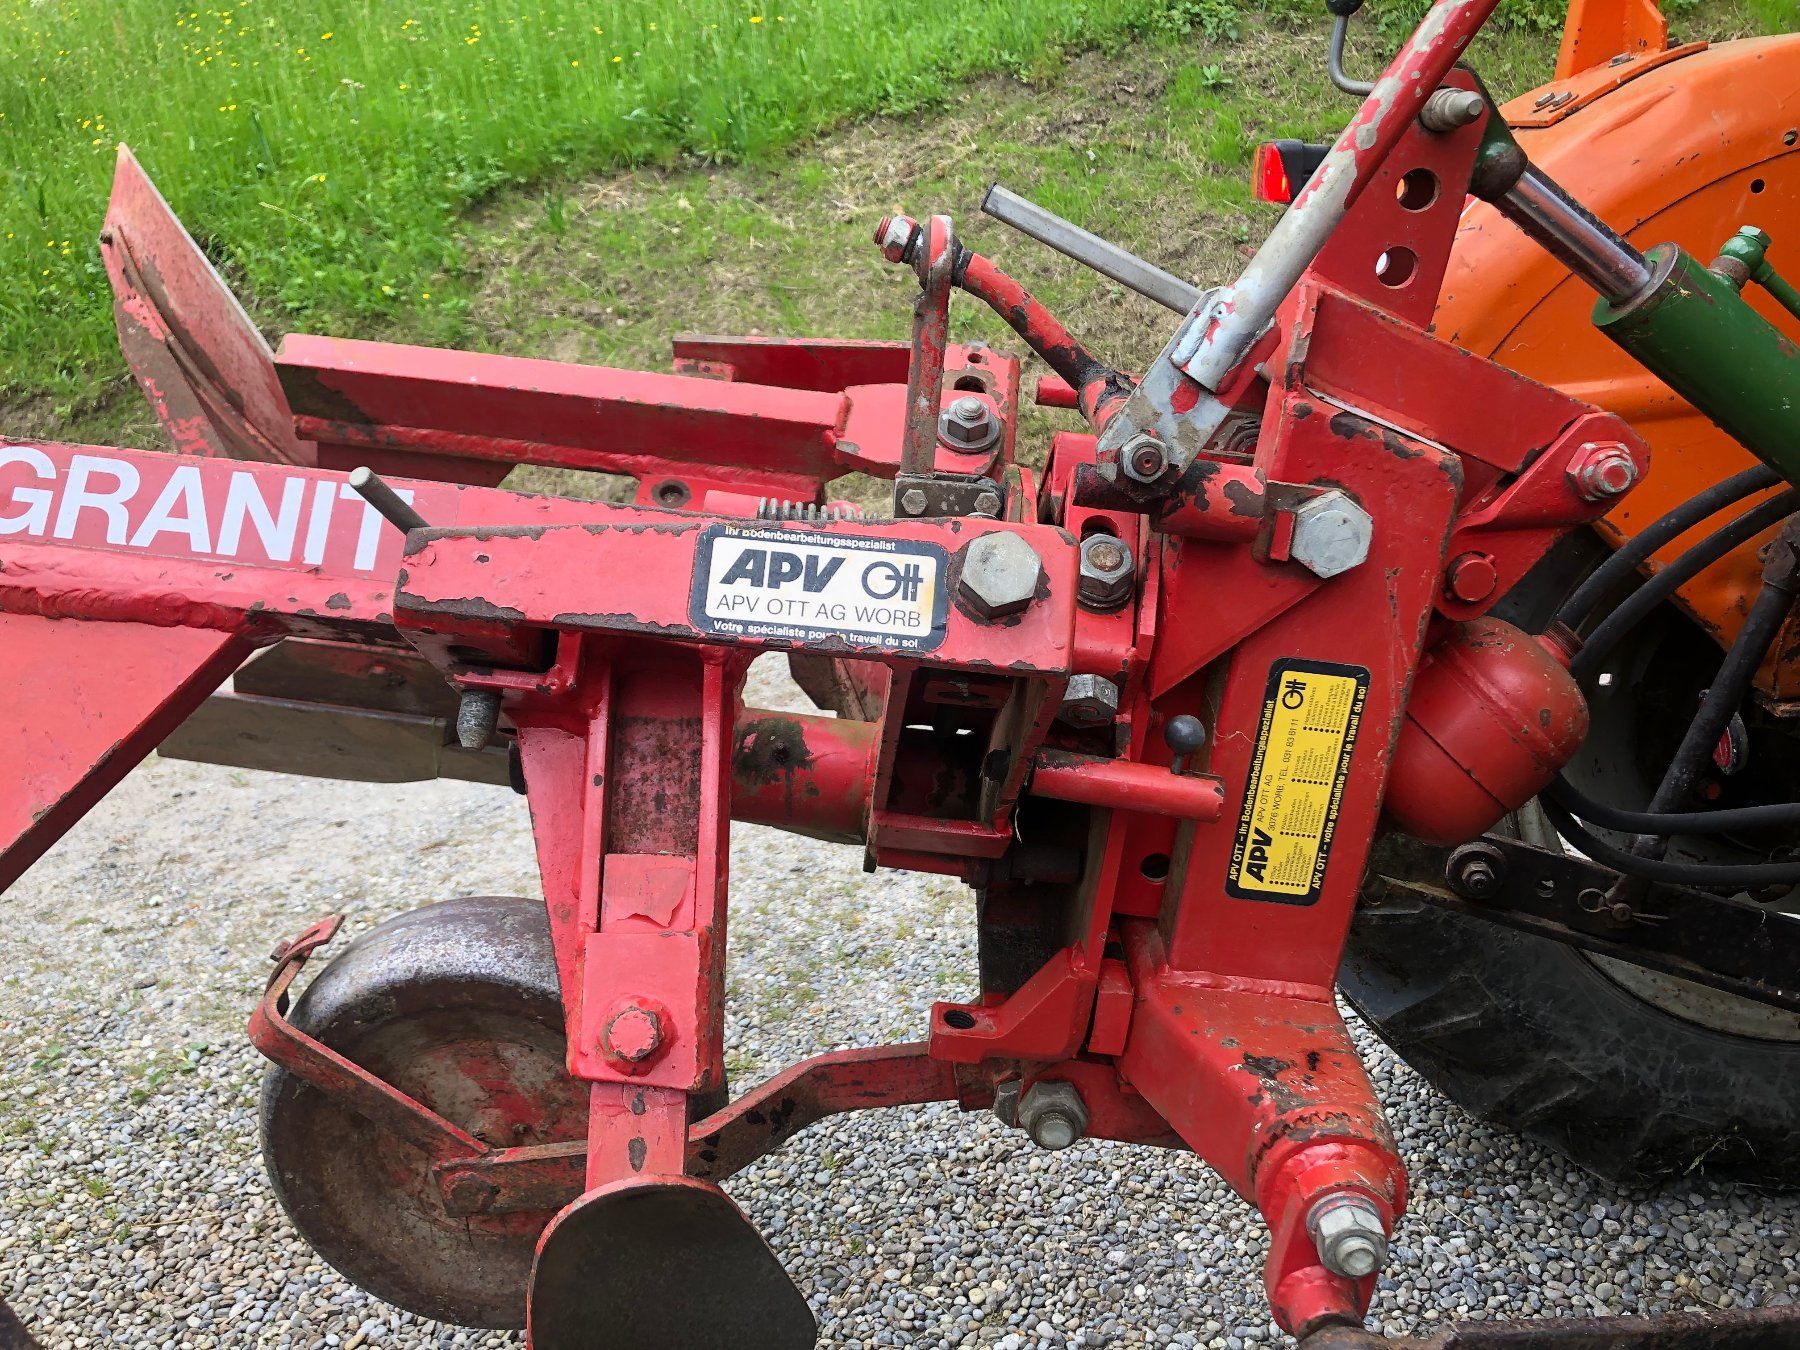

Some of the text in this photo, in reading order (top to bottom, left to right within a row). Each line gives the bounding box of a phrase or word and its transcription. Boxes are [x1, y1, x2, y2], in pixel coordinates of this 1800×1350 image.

[0, 446, 414, 571] GRANIT
[742, 528, 895, 551] Bodenbearbeitungsspezialist
[719, 549, 846, 593] APV
[716, 594, 920, 627] APV OTT AG WORB
[714, 620, 743, 633] Votre
[748, 624, 805, 637] spécialiste
[849, 633, 882, 644] travail
[885, 637, 898, 646] du
[902, 639, 918, 648] sol
[1357, 686, 1366, 699] sol
[1353, 702, 1362, 712] du
[1346, 715, 1359, 741] travail
[1286, 737, 1294, 747] 83
[1241, 700, 1274, 821] Bodenbearbeitungsspezialist
[1282, 750, 1292, 762] 031
[1338, 753, 1350, 773] pour
[1257, 775, 1273, 822] APV OTT AG
[1329, 775, 1345, 819] spécialiste
[1239, 823, 1248, 834] Ihr
[1268, 812, 1278, 831] 3076
[1324, 822, 1334, 842] votre
[1233, 843, 1243, 861] OTT
[1246, 826, 1275, 883] APV
[1316, 852, 1327, 870] OTT
[1229, 863, 1239, 880] APV
[1312, 872, 1322, 889] APV
